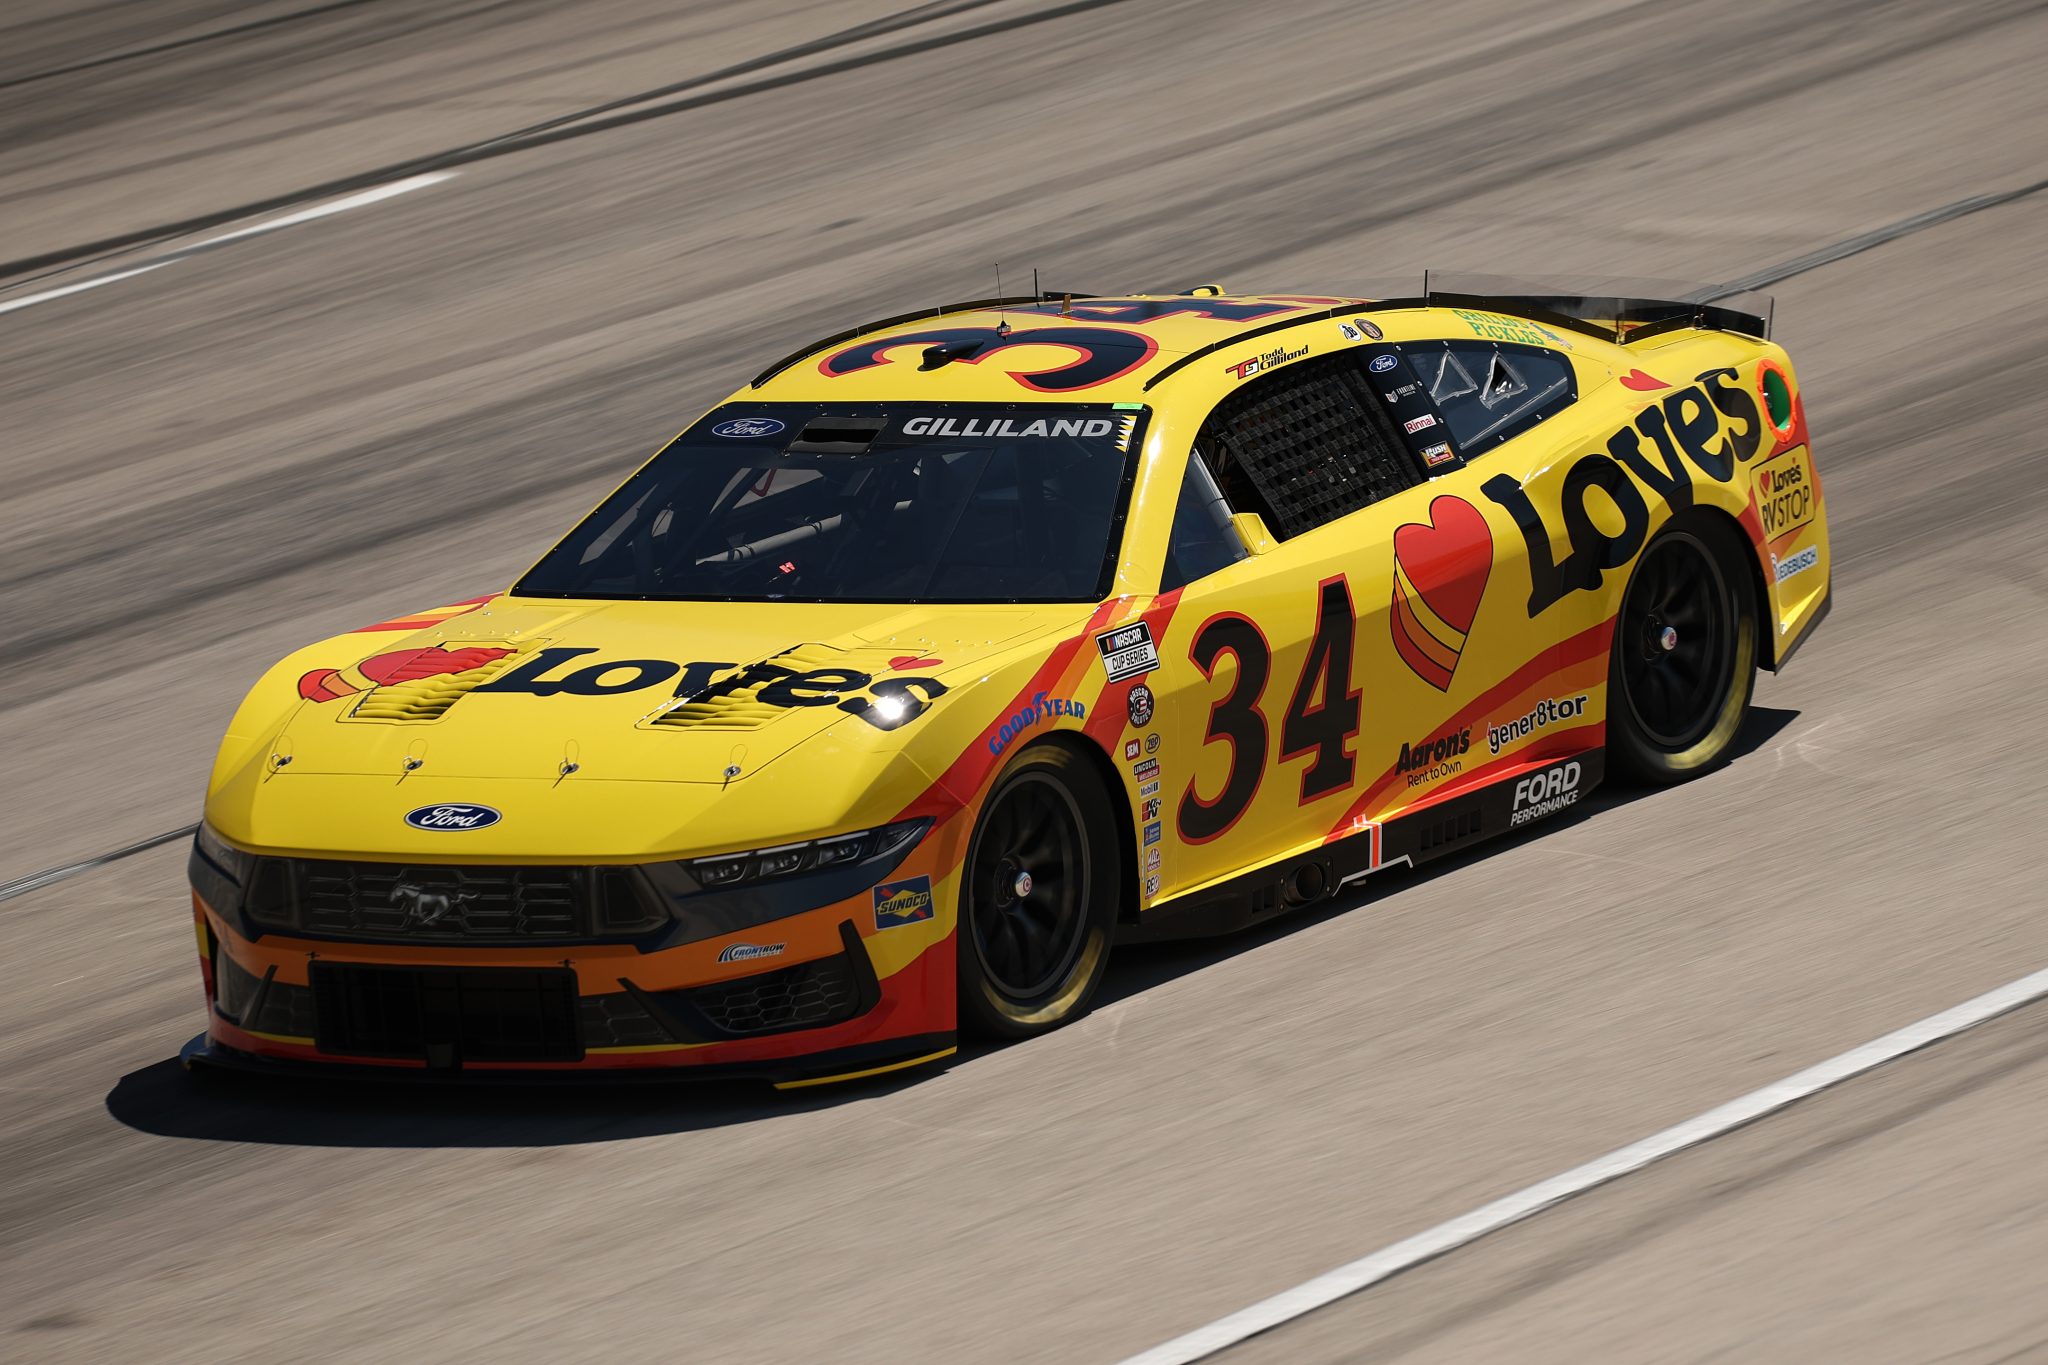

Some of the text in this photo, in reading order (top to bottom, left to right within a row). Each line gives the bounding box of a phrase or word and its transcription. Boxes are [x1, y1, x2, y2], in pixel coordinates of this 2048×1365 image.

[1467, 321, 1545, 345] PICKLES
[1260, 347, 1284, 361] Todd
[1260, 345, 1309, 370] Gilliland
[1375, 357, 1394, 370] Ford
[721, 418, 775, 437] Ford
[902, 417, 1113, 437] GILLILAND
[1406, 415, 1433, 433] Rinnai
[1115, 628, 1143, 649] NASCAR
[1112, 647, 1149, 670] CUP SERIES
[1176, 572, 1363, 846] 34
[1490, 696, 1587, 754] gener8tor
[1394, 727, 1471, 776] Aaron's
[1134, 760, 1156, 774] LINCOLN
[1407, 760, 1462, 788] Rent to Own
[1512, 761, 1581, 811] FORD
[420, 806, 485, 827] Ford
[1510, 790, 1579, 827] PERFORMANCE
[878, 893, 929, 914] SUNOCO
